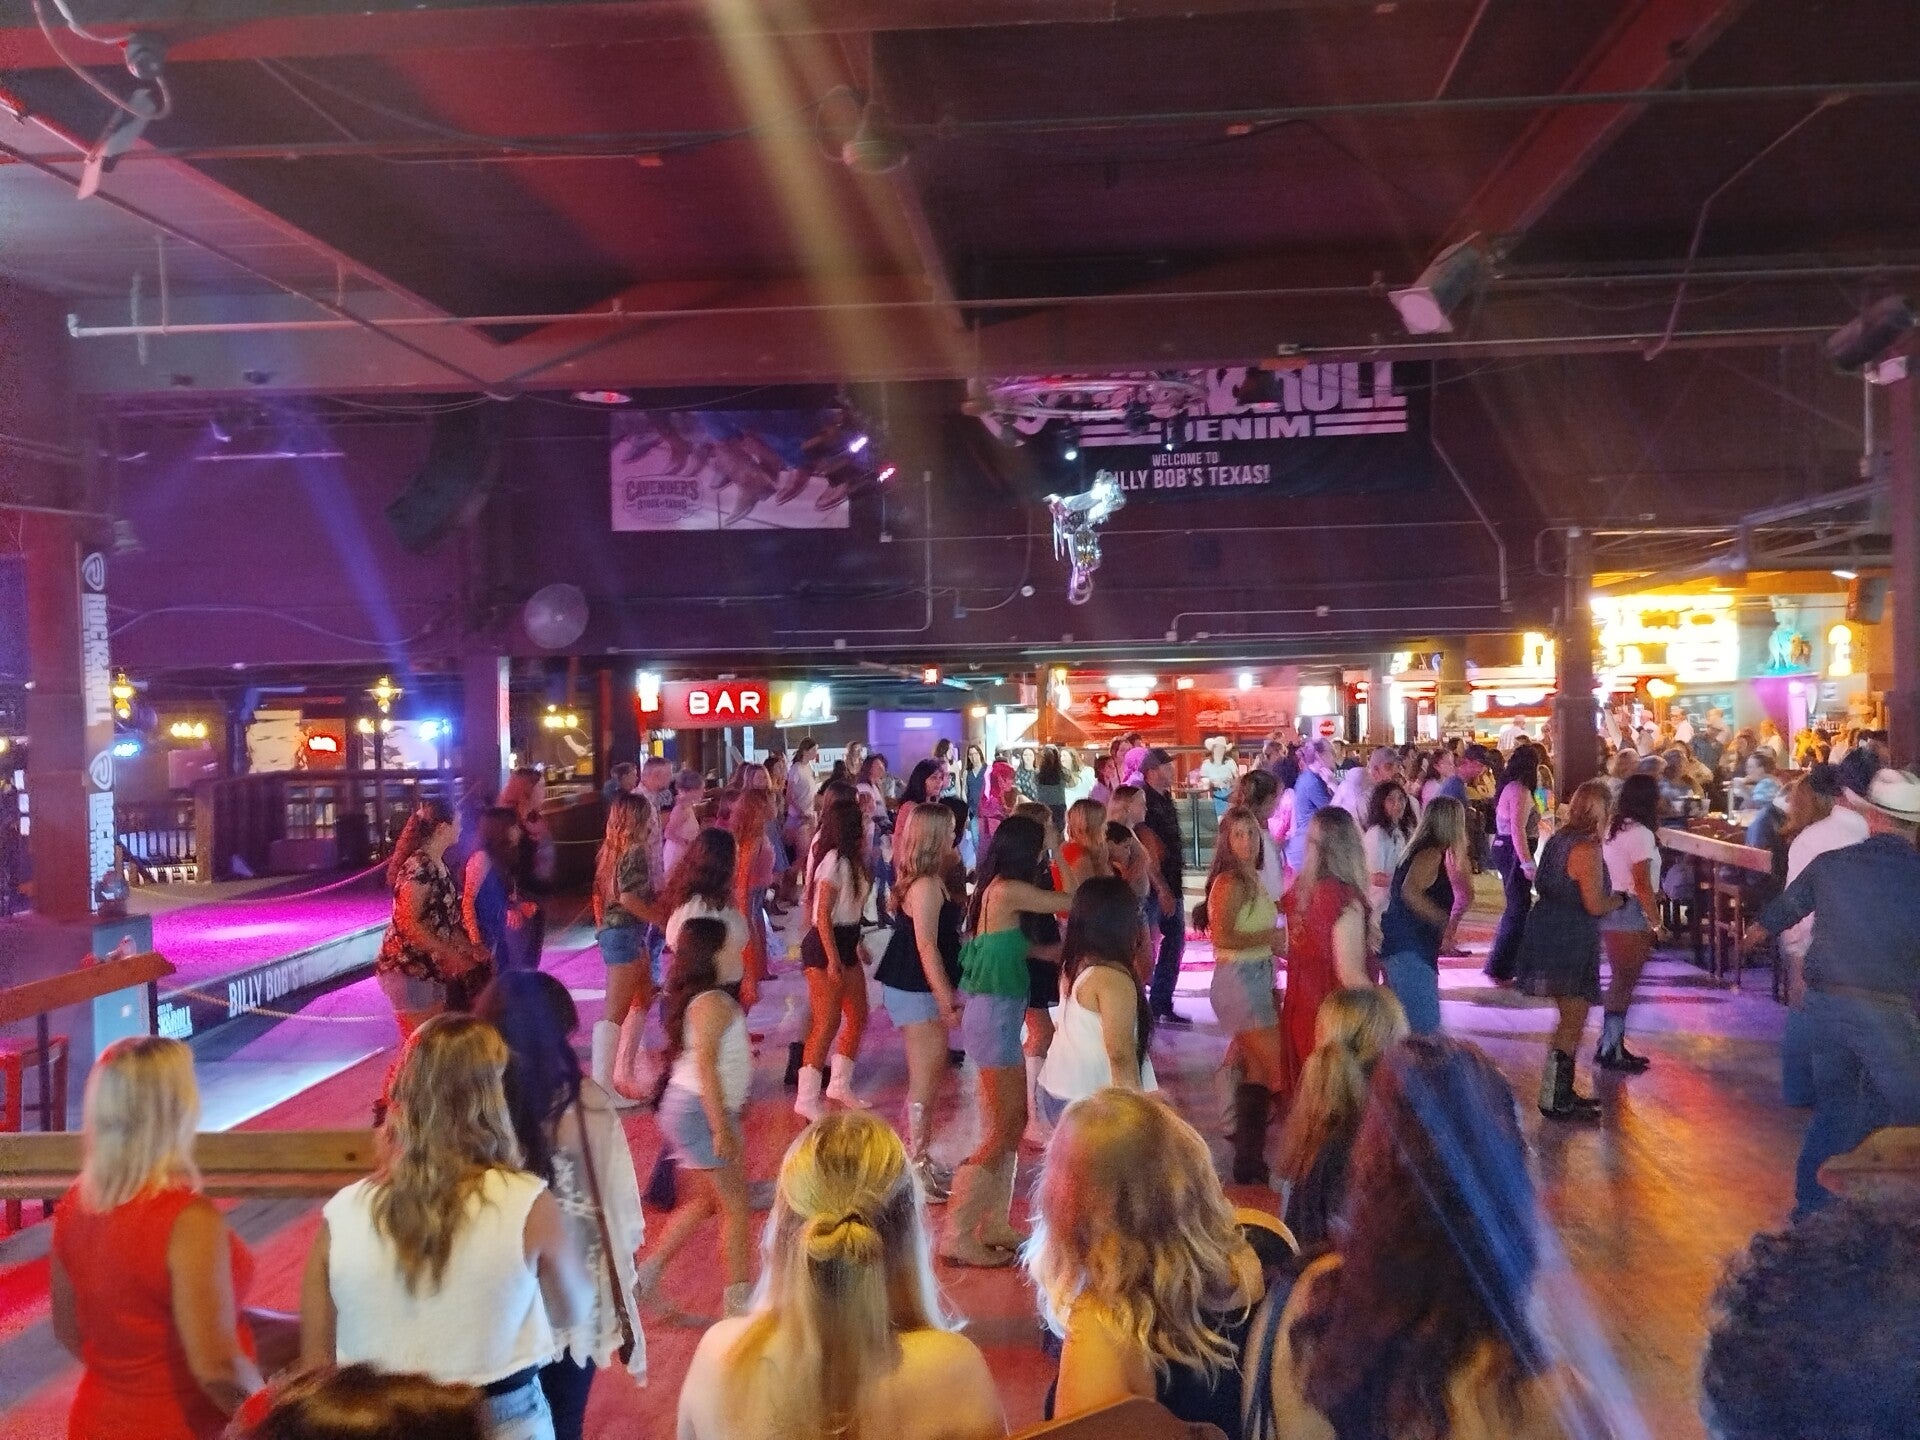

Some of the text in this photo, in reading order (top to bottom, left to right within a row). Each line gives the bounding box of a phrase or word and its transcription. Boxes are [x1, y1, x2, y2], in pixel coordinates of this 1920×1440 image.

[1152, 451, 1220, 468] WELCOME TO
[1104, 464, 1271, 491] ILLY BOB'S TEXAS!
[626, 480, 699, 502] CAVENDER'S
[689, 691, 761, 715] BAR
[229, 963, 300, 1018] BILLY BOB'S
